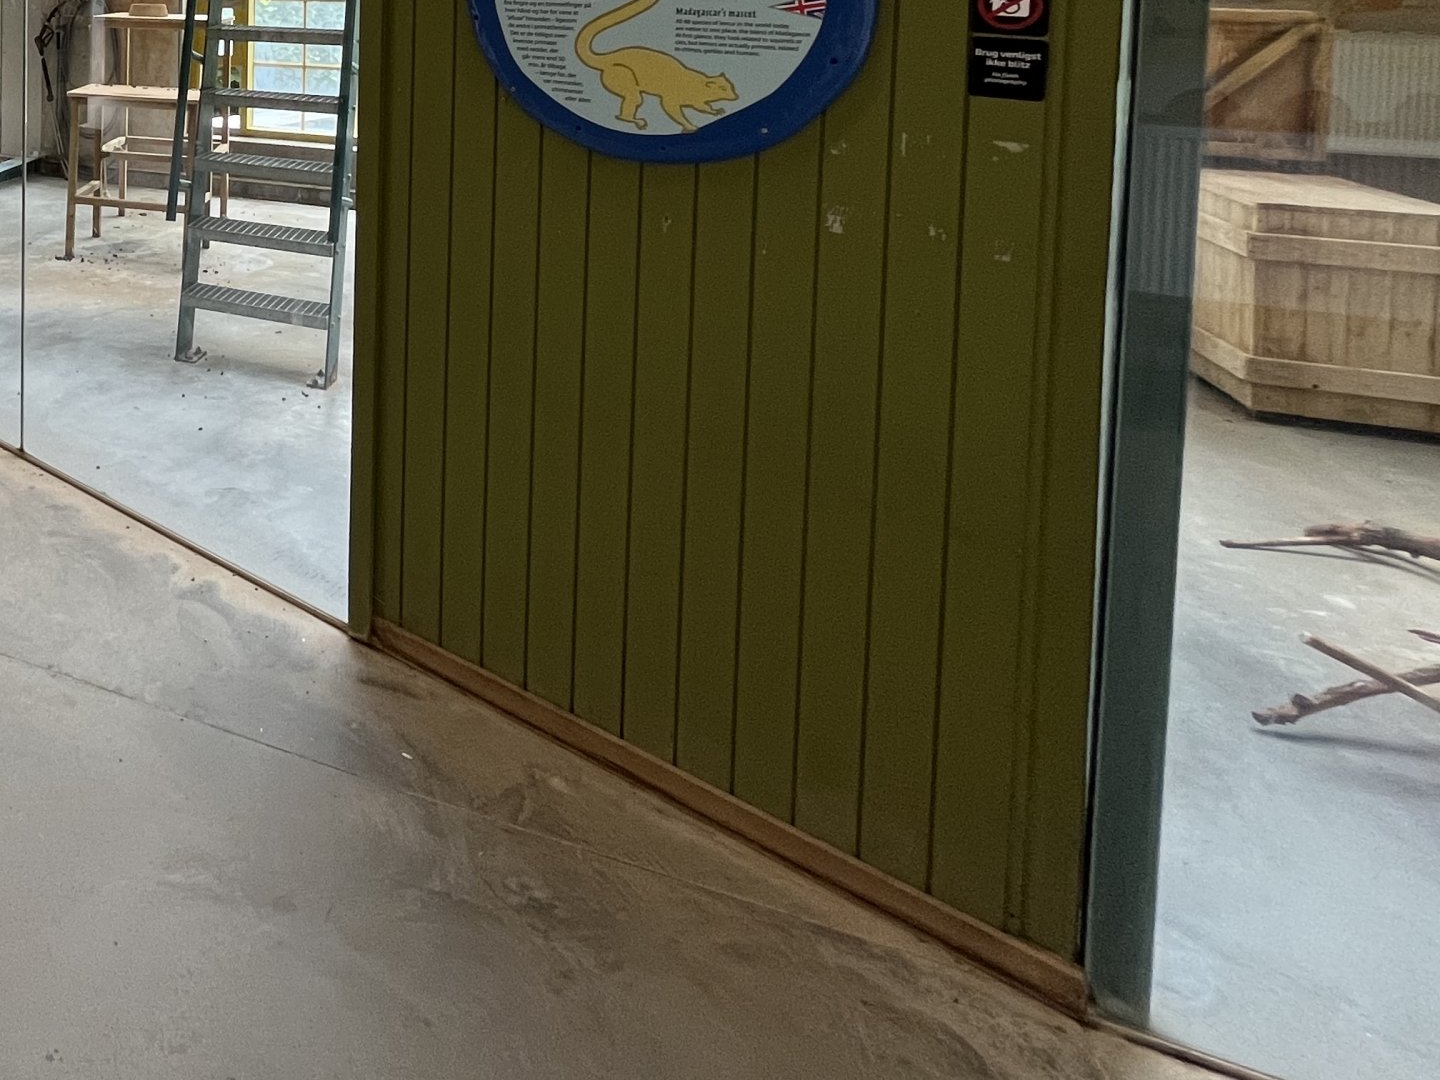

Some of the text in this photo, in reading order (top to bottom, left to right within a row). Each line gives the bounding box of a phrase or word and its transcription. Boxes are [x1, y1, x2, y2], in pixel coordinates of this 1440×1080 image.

[729, 10, 756, 18] mascot
[975, 48, 1042, 61] Brug venligst
[985, 58, 1031, 69] ikke blitz
